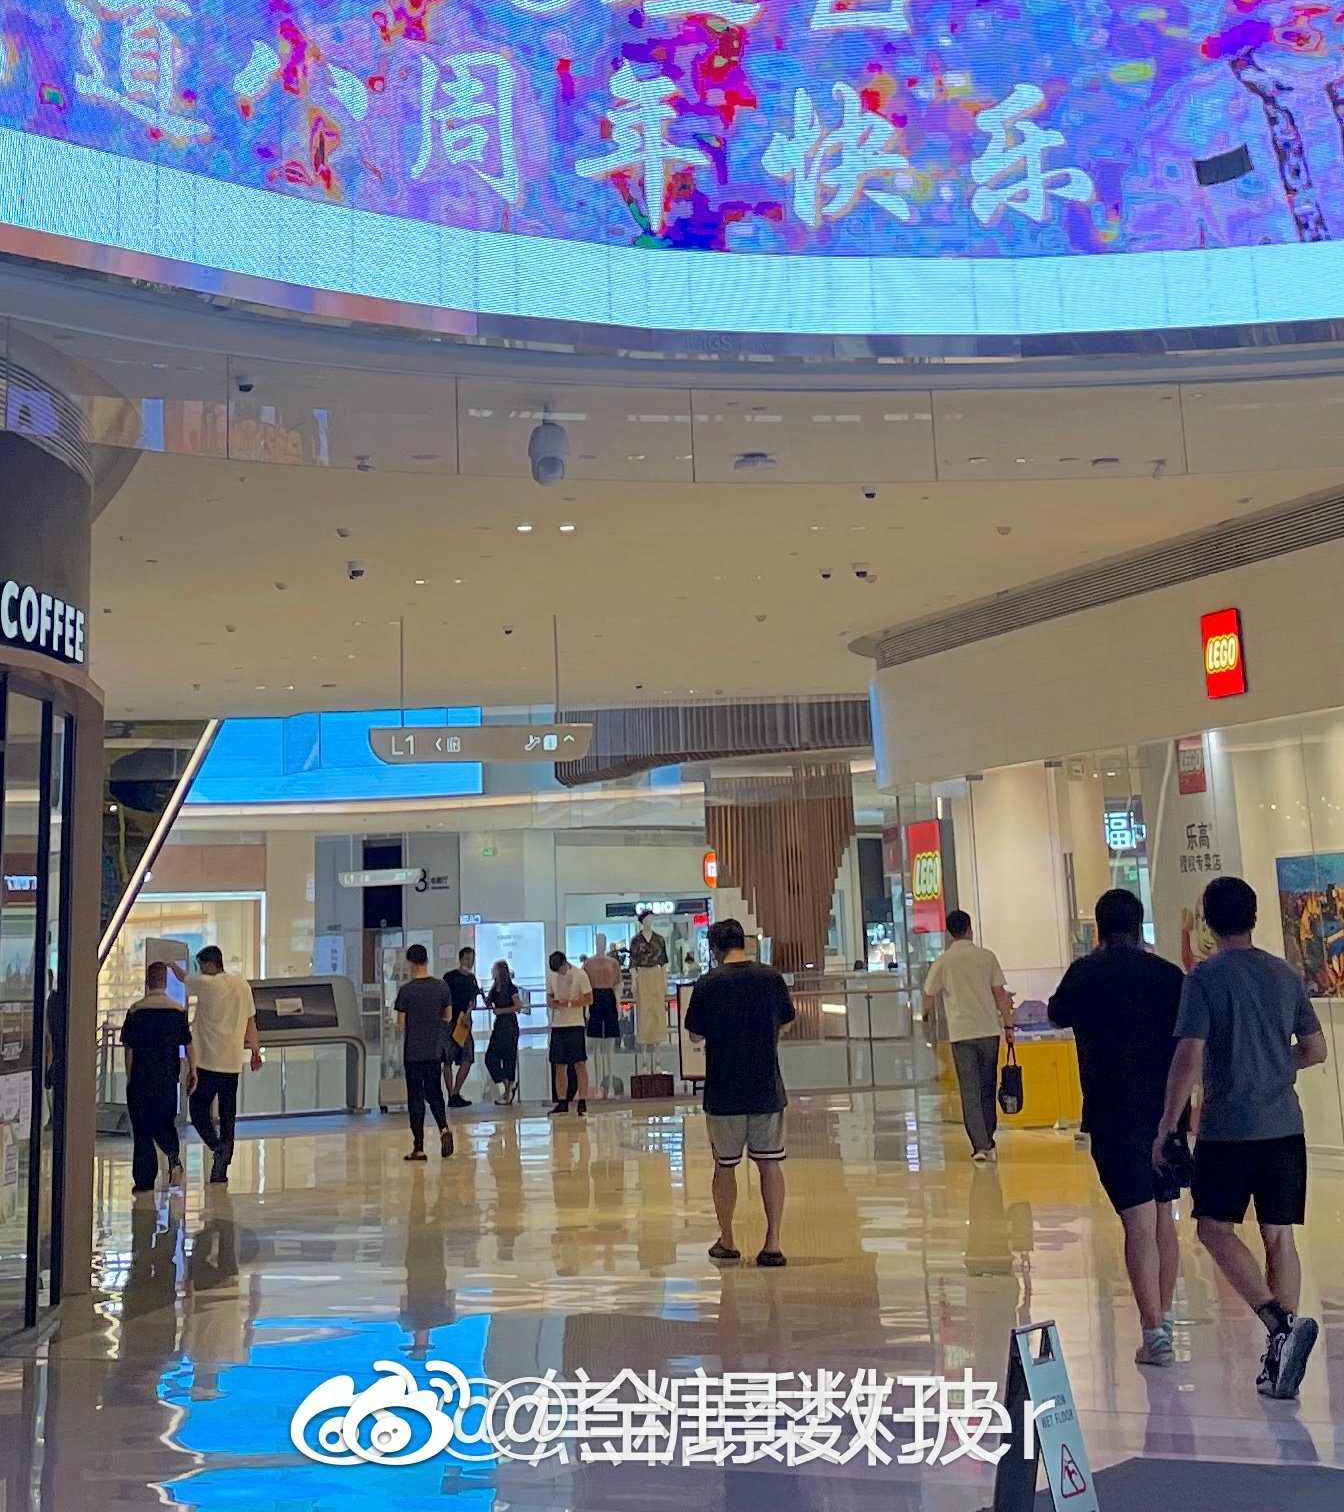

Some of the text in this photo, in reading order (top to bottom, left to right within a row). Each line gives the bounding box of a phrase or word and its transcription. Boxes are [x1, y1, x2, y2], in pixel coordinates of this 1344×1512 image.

[0, 580, 86, 664] COFFEE
[1207, 635, 1237, 672] LEGO
[391, 734, 415, 756] L1
[914, 852, 943, 899] LEGO
